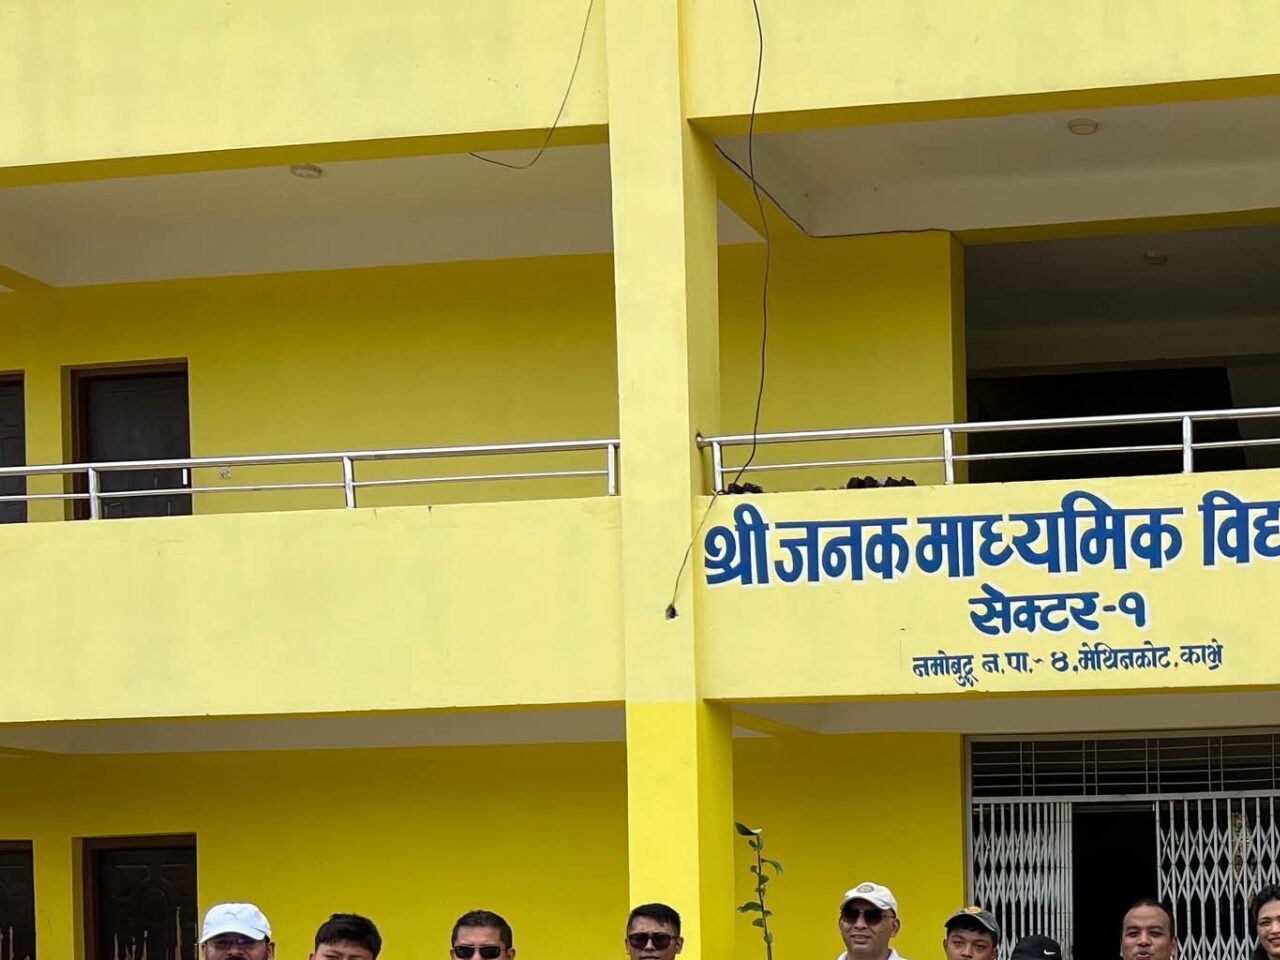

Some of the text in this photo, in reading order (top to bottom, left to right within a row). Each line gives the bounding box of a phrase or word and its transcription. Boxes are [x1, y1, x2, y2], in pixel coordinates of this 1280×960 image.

[704, 502, 770, 585] श्री
[774, 517, 910, 583] जनक
[915, 490, 1184, 578] माध्यमिक
